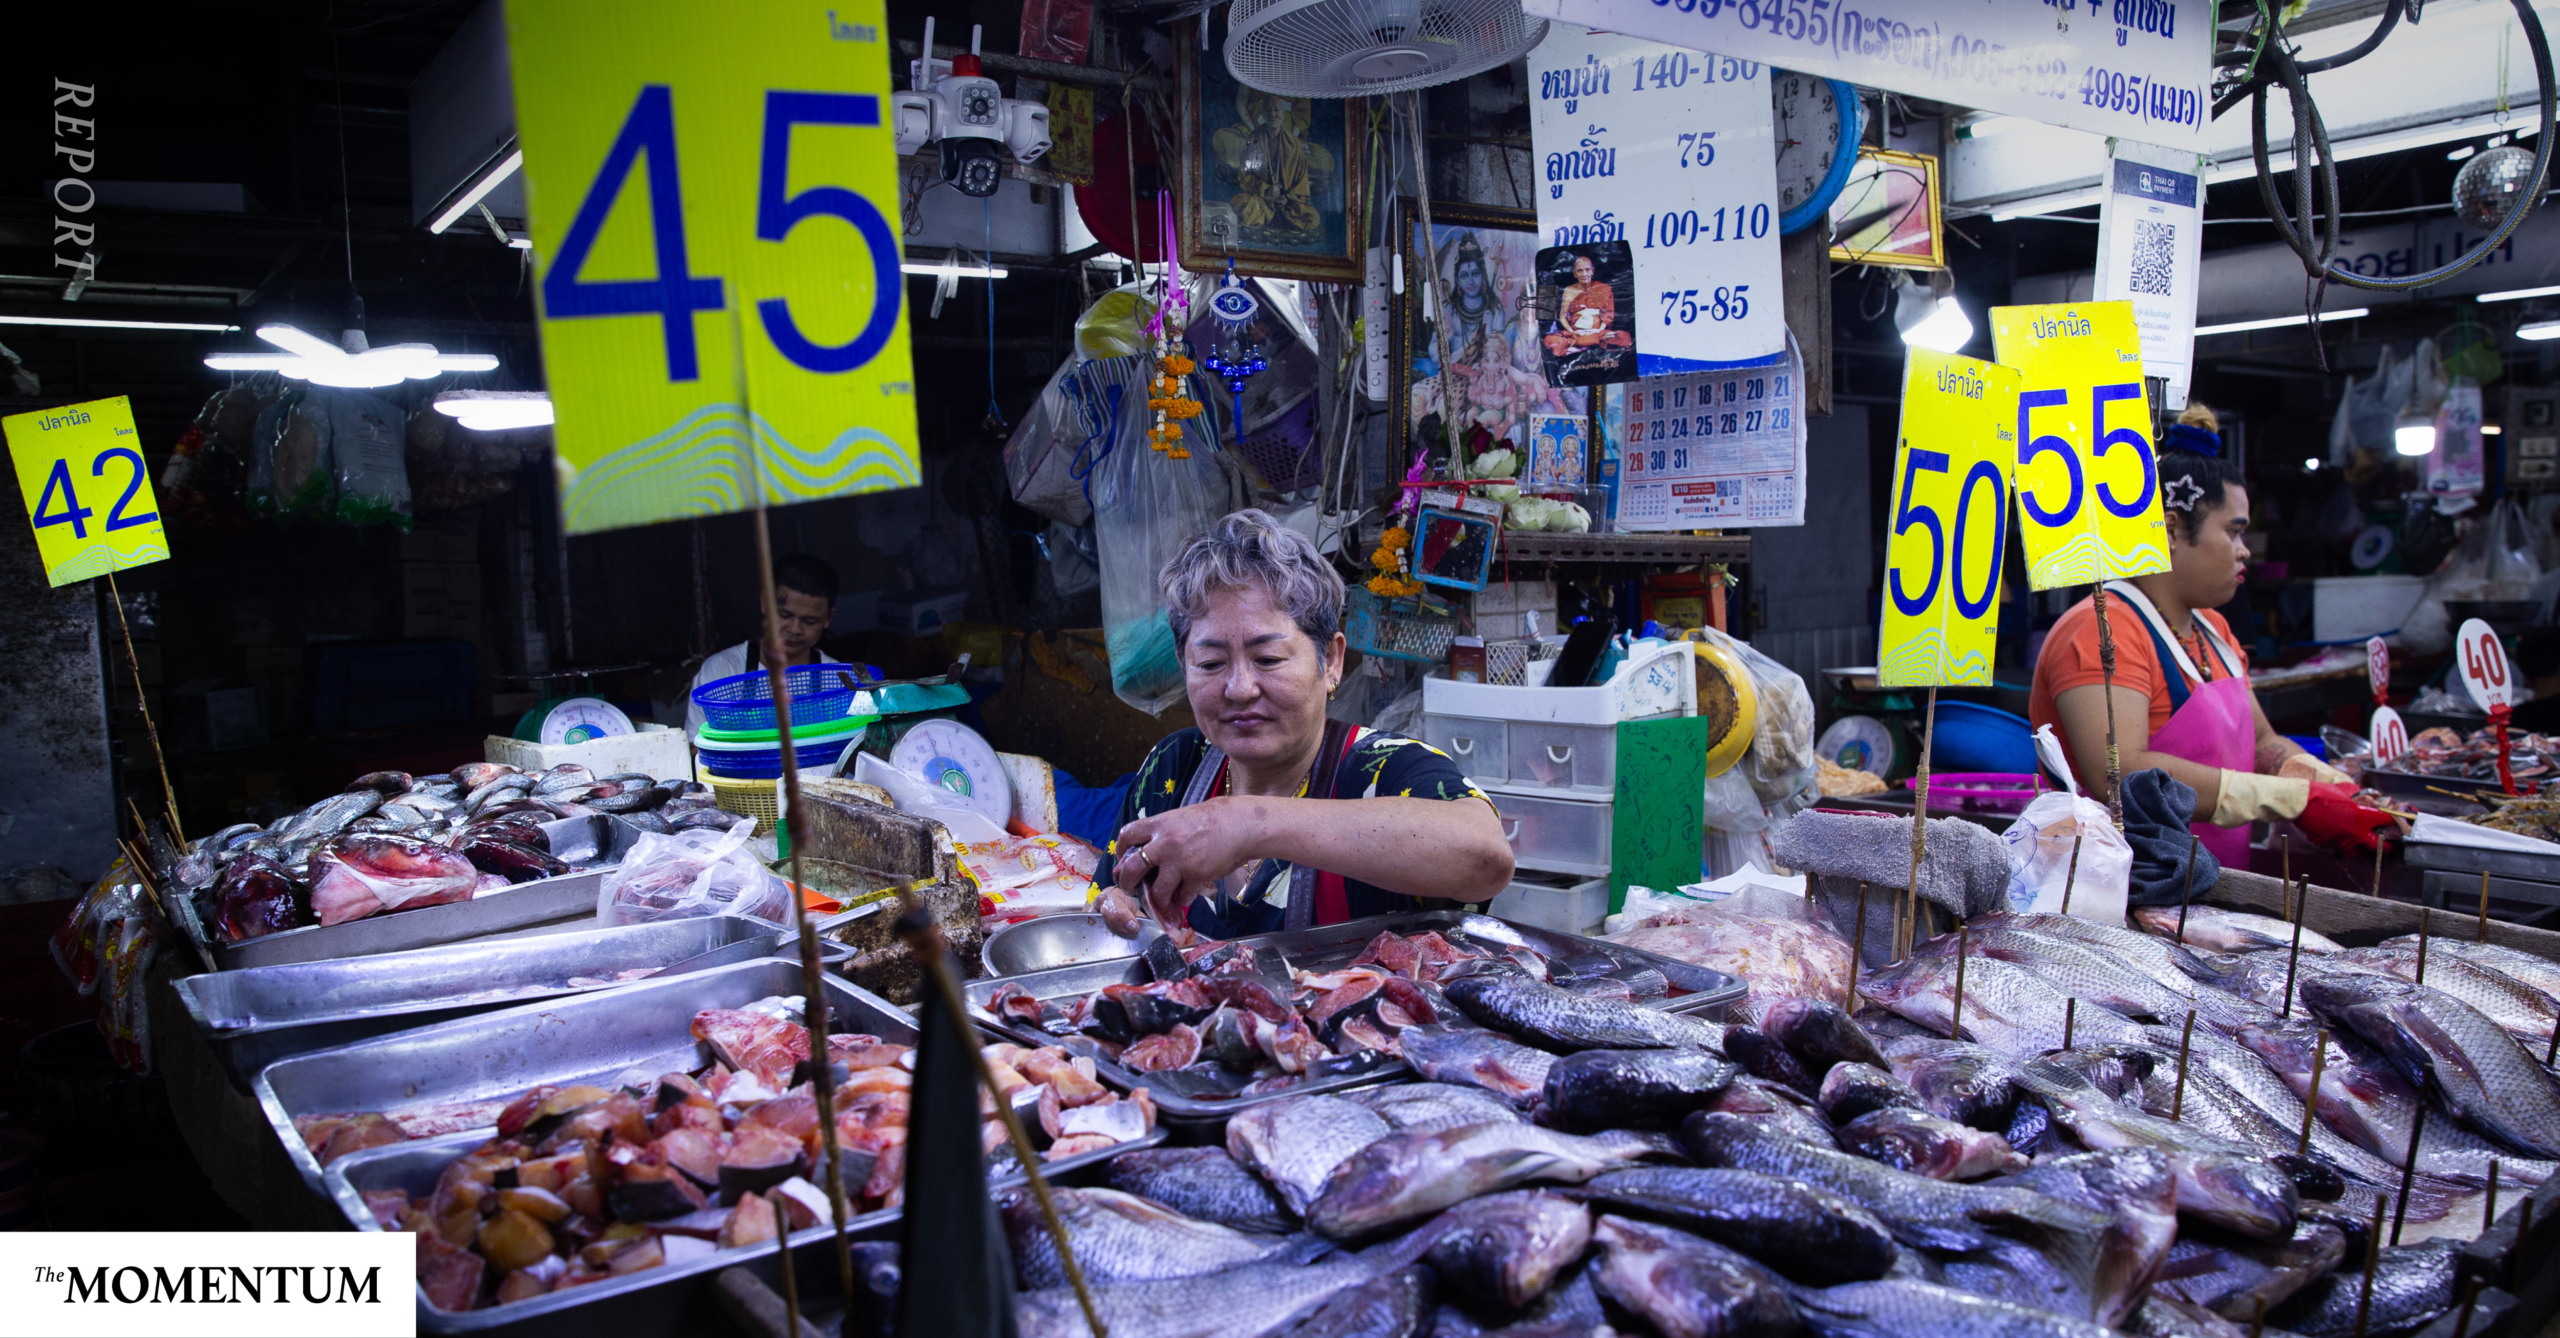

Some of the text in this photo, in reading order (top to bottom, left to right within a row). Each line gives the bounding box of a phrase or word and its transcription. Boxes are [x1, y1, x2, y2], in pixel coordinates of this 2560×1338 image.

[826, 9, 878, 43] โลละ
[1542, 52, 1759, 115] หมูป่า 140-150
[1783, 78, 1799, 99] 12
[1808, 80, 1818, 98] 1
[1822, 95, 1833, 113] 2
[1829, 122, 1839, 144] 3
[1547, 124, 1715, 199] ลูกชิ้น 75
[1819, 151, 1830, 170] 4
[1804, 176, 1815, 196] 5
[2154, 175, 2176, 188] THAI QR
[2154, 185, 2176, 195] PAYMENT
[1782, 187, 1794, 205] 6
[543, 84, 903, 382] 45
[1643, 203, 1769, 248] 100-110
[1660, 285, 1749, 326] 75-85
[2032, 311, 2091, 339] ปลานิล
[2116, 349, 2139, 363] โลละ
[1632, 375, 1789, 412] 15 16 17 18 19 20 21
[1937, 364, 1984, 401] ปลานิล
[38, 409, 91, 431] ปลานิล
[114, 427, 134, 436] โลละ
[1629, 407, 1790, 442] 22 23 24 25 26 27 28
[1996, 423, 2013, 442] โลละ
[1629, 451, 1644, 472] 29
[1651, 450, 1666, 471] 30
[1674, 448, 1688, 469] 31
[2017, 382, 2157, 528] 55
[32, 447, 159, 540] 42
[1889, 447, 2006, 620] 50
[2150, 520, 2165, 529] บาท
[1984, 626, 1996, 635] บาท
[2464, 633, 2505, 690] 40
[2376, 719, 2404, 764] 40
